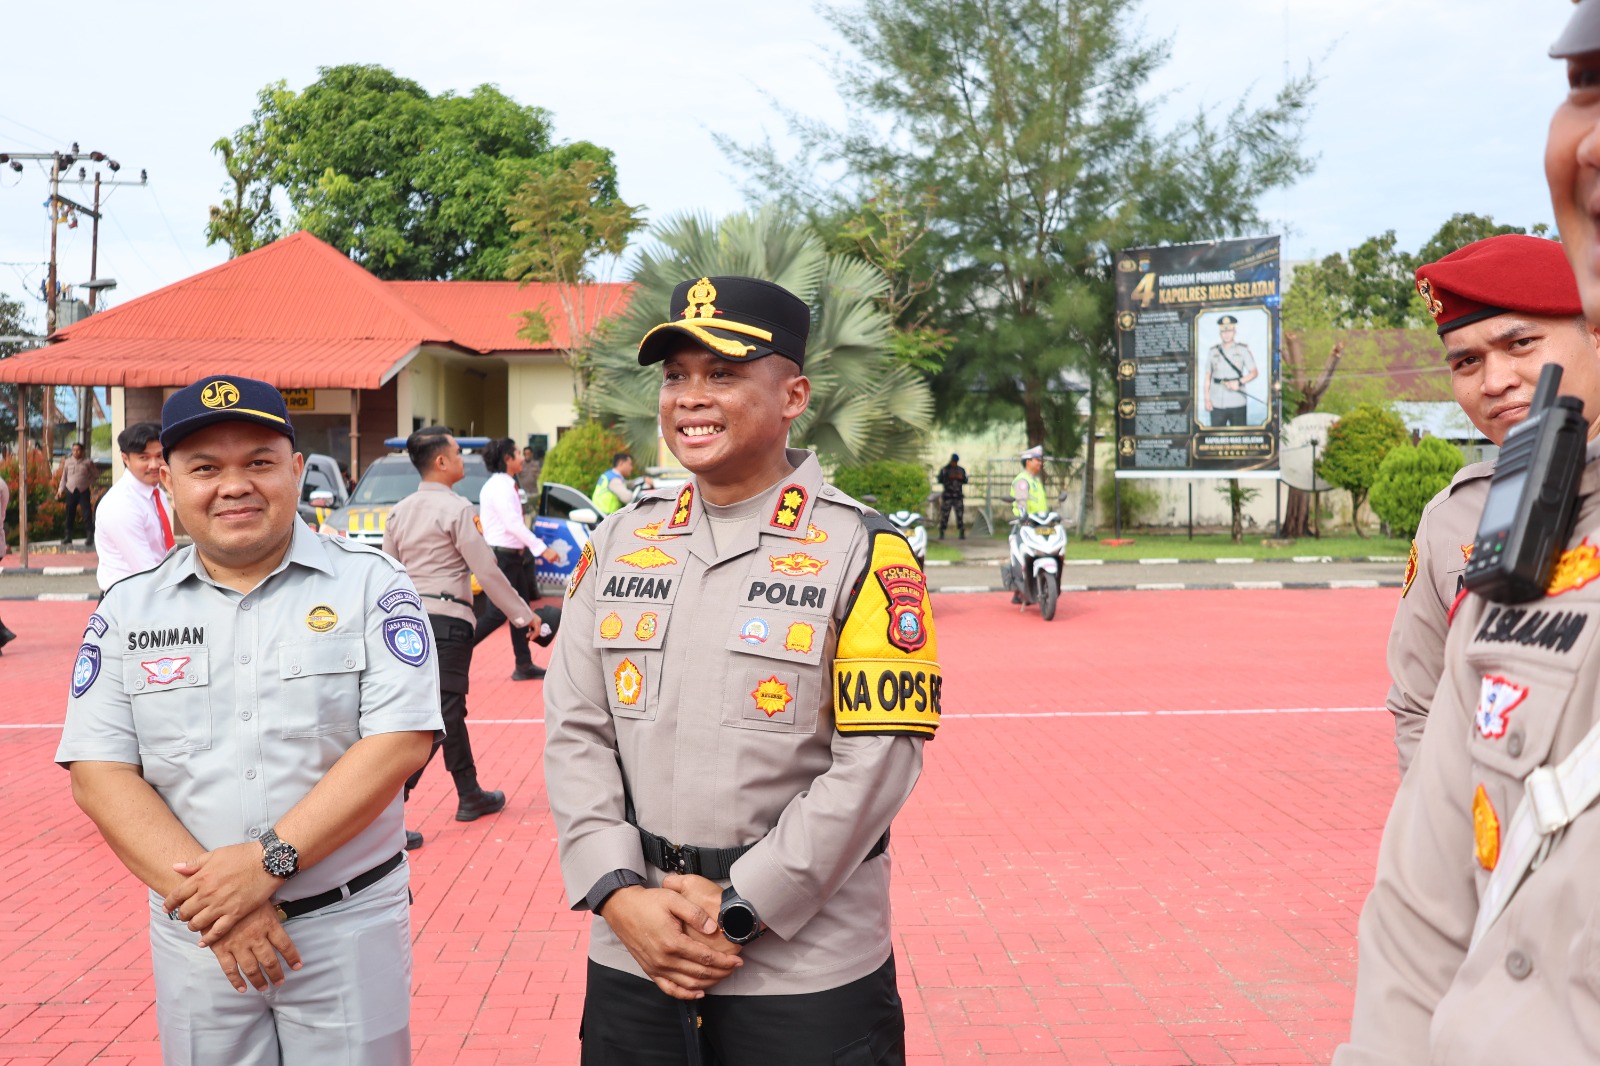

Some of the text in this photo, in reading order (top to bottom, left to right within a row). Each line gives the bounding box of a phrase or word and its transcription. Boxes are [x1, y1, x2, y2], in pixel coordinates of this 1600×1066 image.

[1130, 272, 1156, 308] 4
[1158, 270, 1236, 286] PROGRAM PRIORITAS
[1158, 280, 1276, 304] KAPOLRES NIAS SELATAN
[882, 567, 922, 582] POLRES
[602, 575, 673, 600] ALFIAN
[747, 581, 827, 609] POLRI
[383, 593, 403, 607] CABANG
[127, 626, 204, 651] SONIMAN
[388, 622, 401, 631] JASA
[837, 670, 872, 712] KA
[877, 669, 928, 713] OPS
